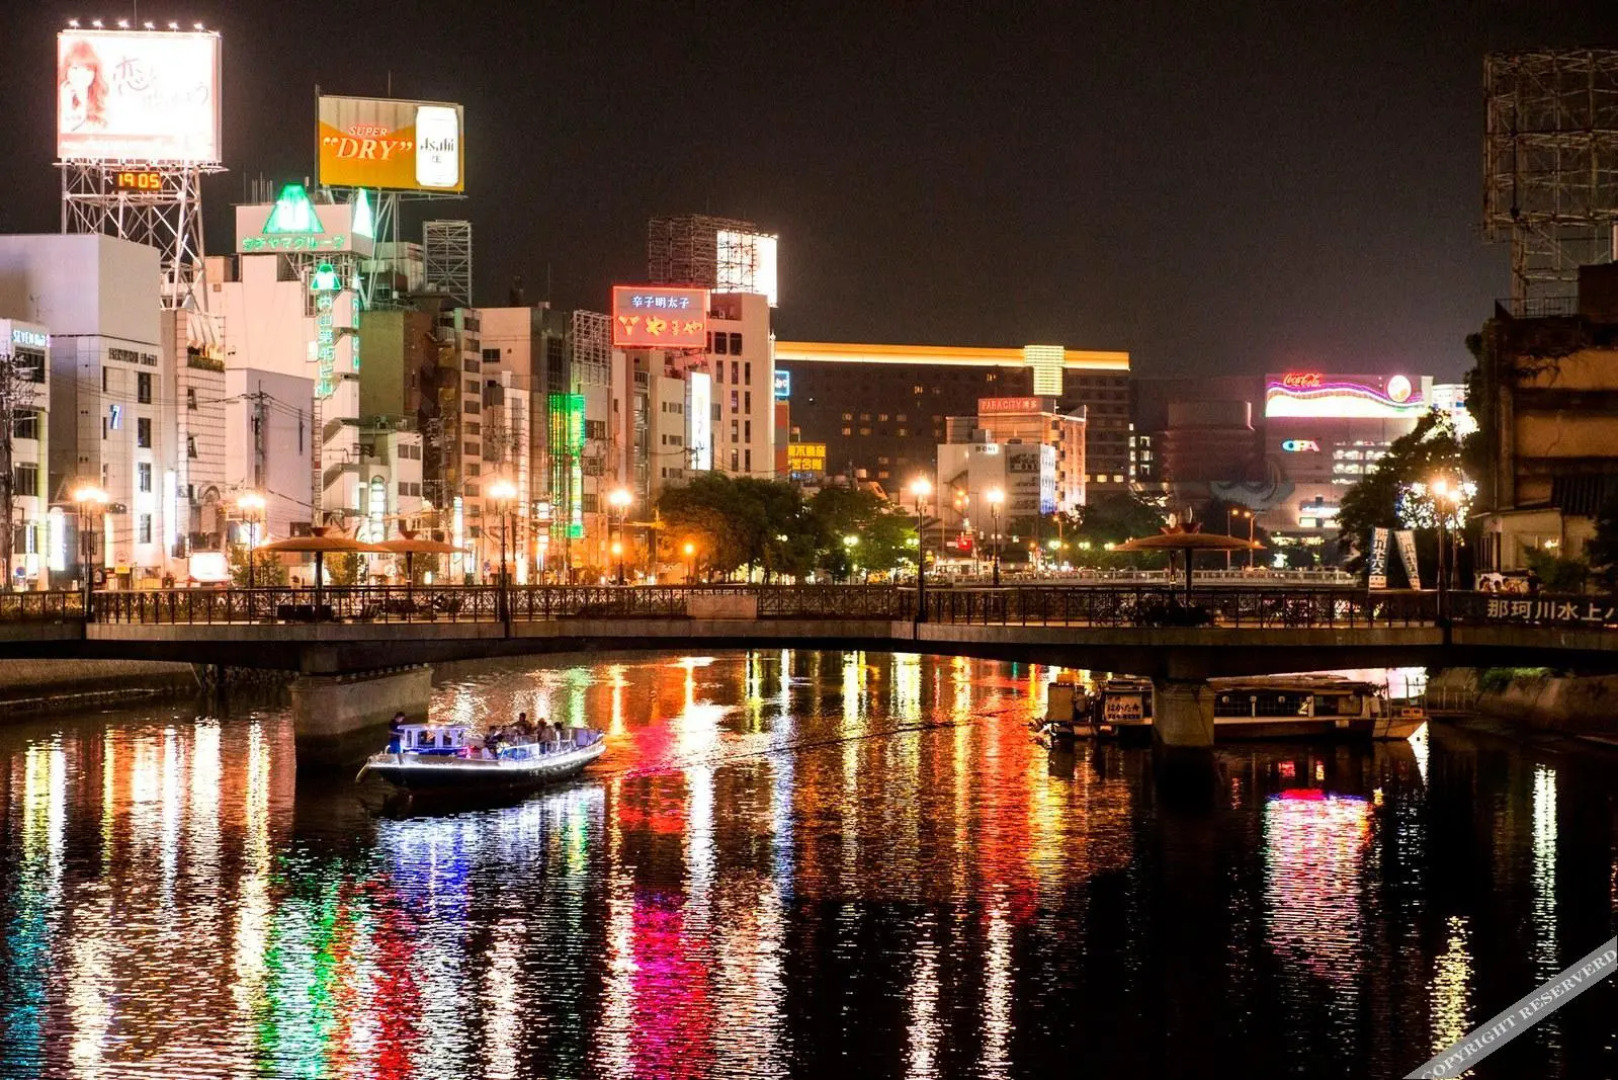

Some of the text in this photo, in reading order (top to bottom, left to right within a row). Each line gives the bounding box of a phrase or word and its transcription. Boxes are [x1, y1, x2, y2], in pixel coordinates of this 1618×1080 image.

[348, 126, 388, 136] SUPER
[632, 296, 689, 308] 辛子明太子
[1282, 439, 1320, 452] OPA
